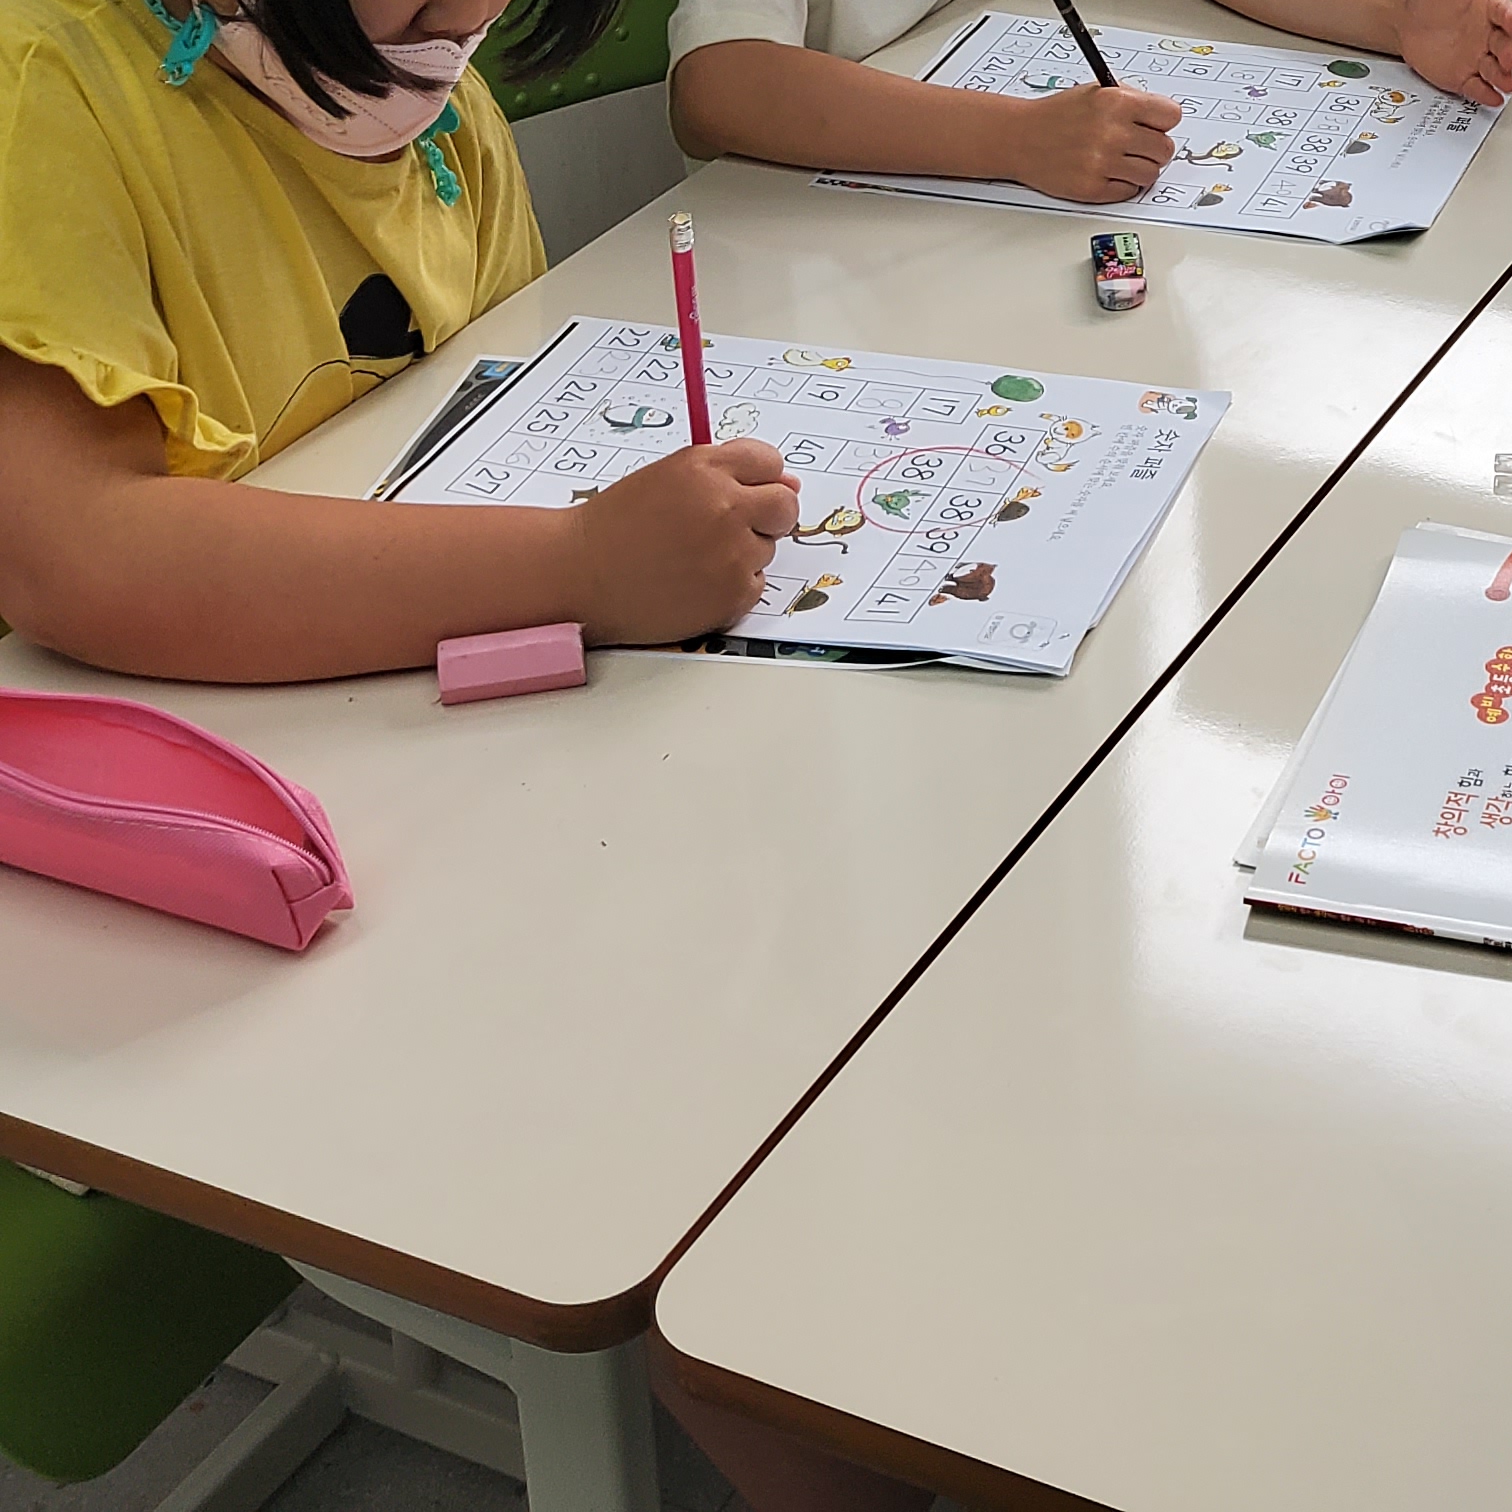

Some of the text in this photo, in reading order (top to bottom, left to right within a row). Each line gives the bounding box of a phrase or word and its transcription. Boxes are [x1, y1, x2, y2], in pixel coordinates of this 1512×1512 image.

[1044, 42, 1077, 59] 22
[983, 56, 1015, 72] 24
[1183, 63, 1209, 75] 19
[1275, 73, 1305, 87] 17
[1329, 96, 1361, 112] 36
[1266, 109, 1298, 127] 38
[1446, 117, 1471, 132] 퍼즐
[1300, 135, 1333, 153] 38
[1285, 155, 1318, 174] 39
[1151, 186, 1186, 204] 46
[1255, 197, 1288, 213] 41
[637, 358, 679, 382] 22
[555, 381, 597, 402] 24
[815, 383, 847, 402] 19
[922, 397, 960, 416] 17
[527, 408, 569, 434] 25
[784, 440, 825, 464] 40
[985, 430, 1025, 456] 36
[555, 447, 597, 473] 25
[1130, 428, 1180, 480] 숫자 퍼즐
[901, 453, 944, 481] 38
[466, 468, 510, 494] 27
[940, 495, 983, 522] 38
[916, 527, 959, 553] 39
[866, 592, 911, 615] 41
[1432, 769, 1483, 839] 창의적 힘과
[1288, 774, 1350, 885] FACTO 아이
